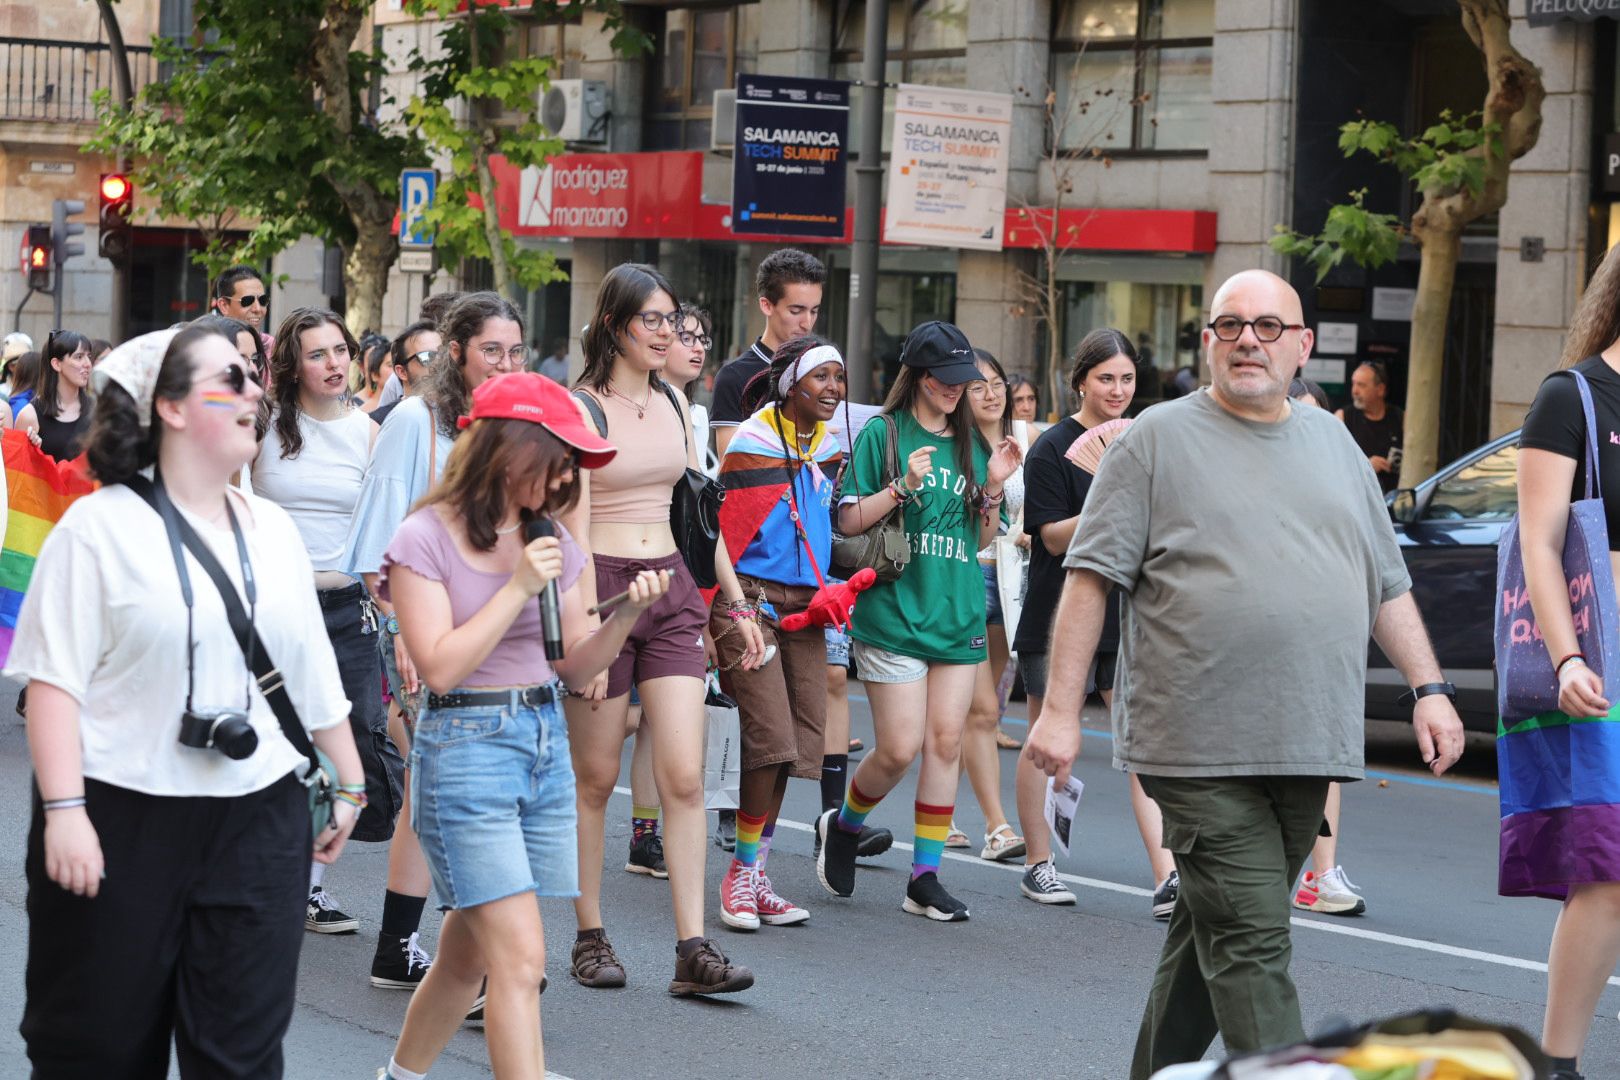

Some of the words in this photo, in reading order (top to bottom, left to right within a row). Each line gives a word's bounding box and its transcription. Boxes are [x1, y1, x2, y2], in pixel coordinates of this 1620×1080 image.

[743, 127, 840, 146] SALAMANCA
[904, 122, 1000, 144] SALAMANCA
[743, 143, 782, 159] TECH
[783, 146, 839, 162] SUMMIT
[904, 138, 942, 153] TECH
[944, 142, 999, 159] SUMMIT
[554, 163, 628, 196] rodríguez
[777, 164, 786, 173] de
[786, 165, 804, 175] junio
[403, 176, 429, 242] P
[552, 206, 628, 228] manzano
